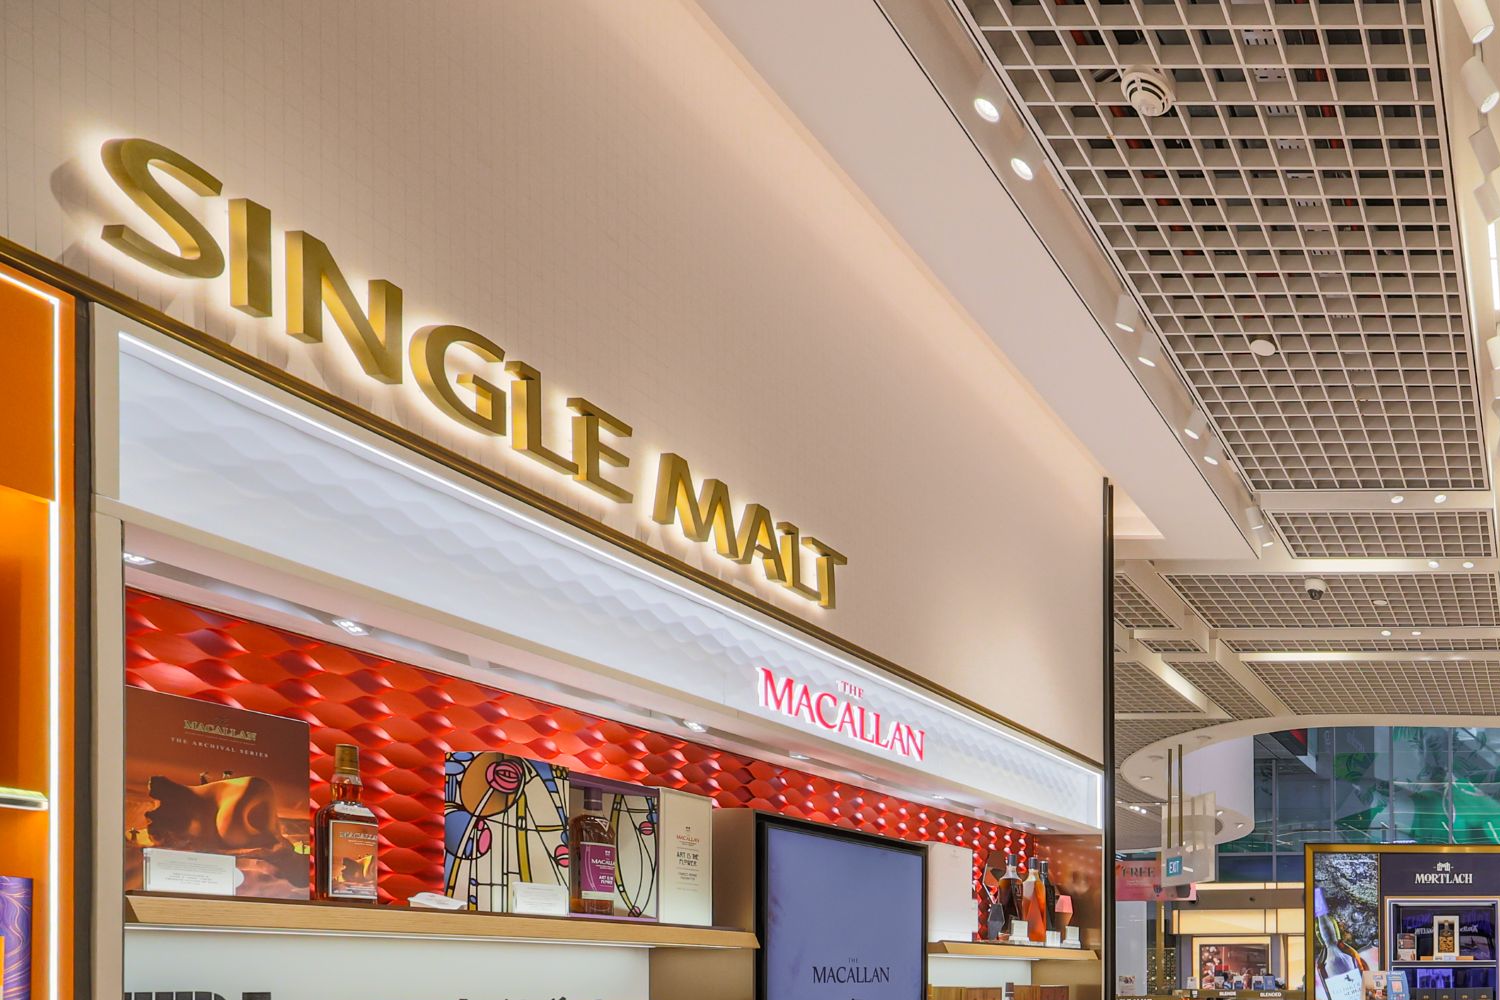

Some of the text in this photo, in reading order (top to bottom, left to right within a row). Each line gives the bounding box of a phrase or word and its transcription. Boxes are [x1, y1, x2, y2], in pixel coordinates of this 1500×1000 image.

[100, 137, 848, 609] SINGLE MALT
[841, 680, 864, 698] THE
[759, 667, 925, 761] MACALLAN
[183, 719, 257, 741] MACALLAN
[171, 736, 269, 759] THE ARCHIVAL SERIES
[1169, 860, 1180, 874] EXIT
[1415, 873, 1473, 885] MORTLACH
[812, 966, 890, 984] MACALLAN
